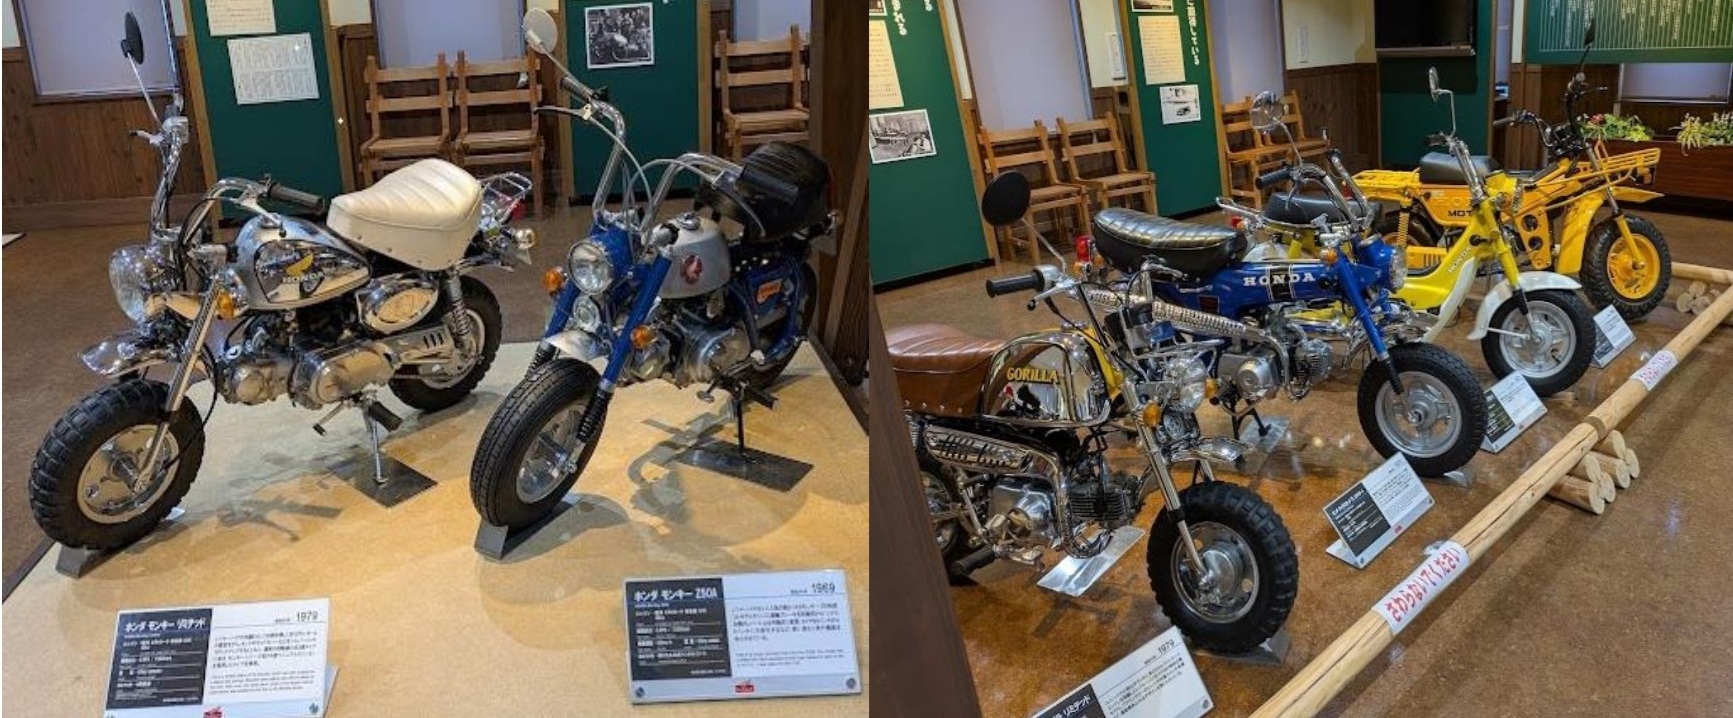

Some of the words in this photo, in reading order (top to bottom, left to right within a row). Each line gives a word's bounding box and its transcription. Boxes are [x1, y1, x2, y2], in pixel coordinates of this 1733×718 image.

[1448, 246, 1472, 273] HONDA
[282, 271, 324, 283] HONDA
[1242, 272, 1315, 286] HONDA
[1006, 368, 1058, 381] GORILLA
[811, 582, 836, 594] 1969
[1385, 547, 1461, 622] さわらないでください
[634, 590, 658, 601] ホンダ
[661, 589, 693, 599] モンキー
[296, 610, 319, 622] 1979
[124, 621, 147, 632] ホンダ
[148, 619, 175, 631] モンキー
[176, 616, 206, 629] リミテッド
[1157, 638, 1176, 654] 1979
